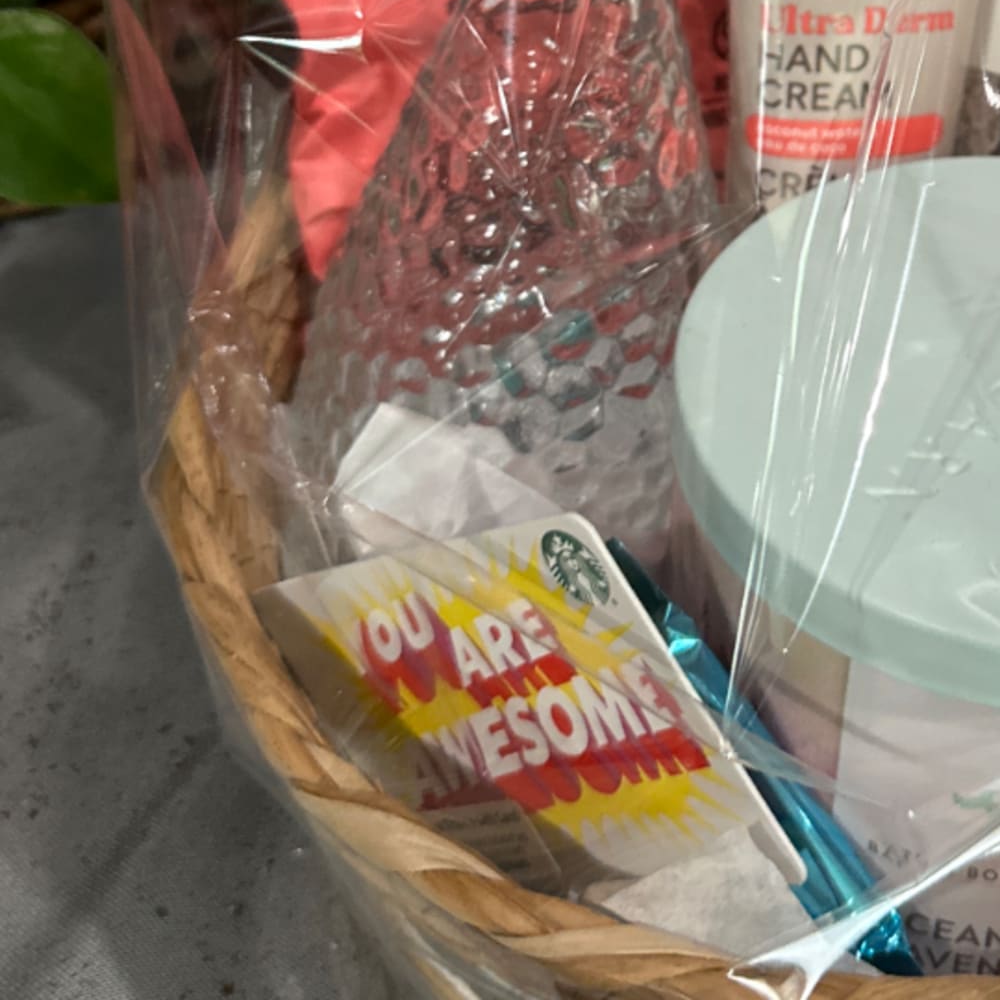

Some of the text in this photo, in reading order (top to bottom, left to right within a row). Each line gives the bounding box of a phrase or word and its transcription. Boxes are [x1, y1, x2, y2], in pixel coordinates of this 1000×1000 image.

[758, 44, 869, 73] HAND
[759, 80, 893, 112] CREAM
[346, 590, 436, 675] OU
[449, 597, 558, 688] ARE
[410, 656, 678, 805] AWESOME
